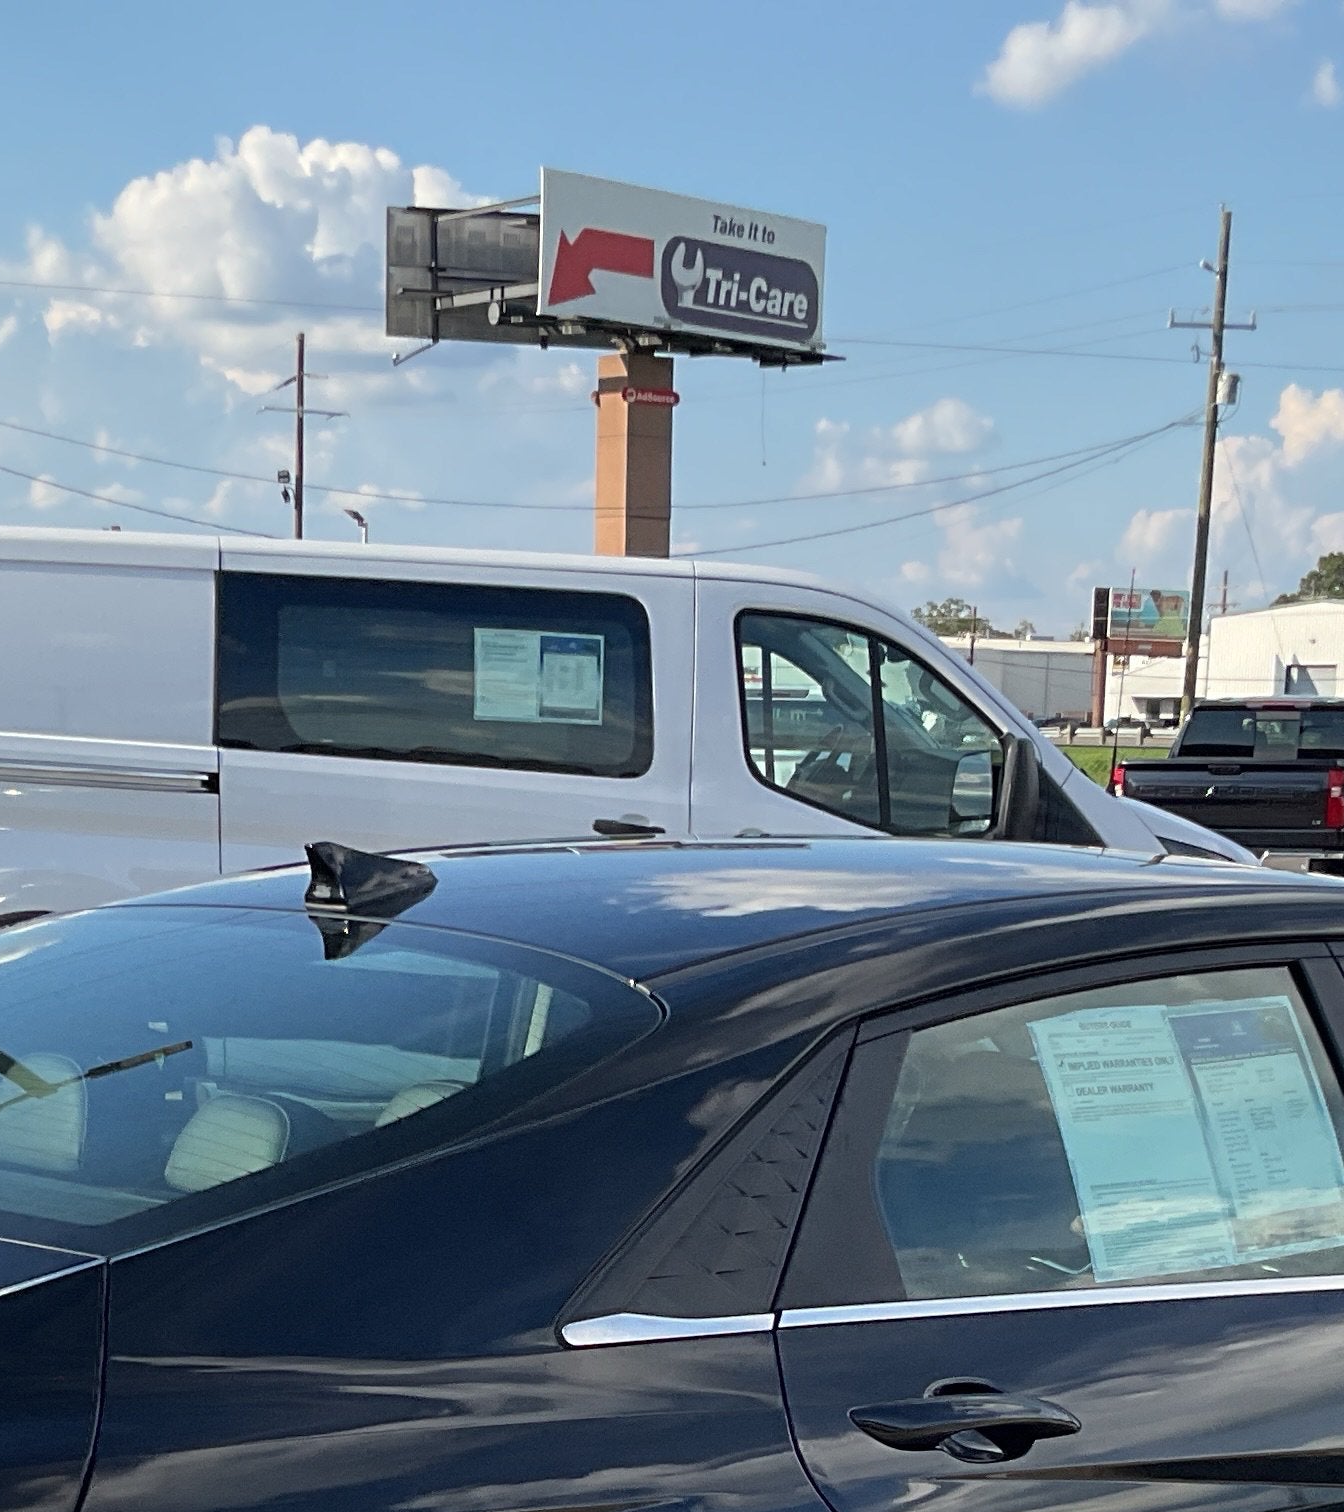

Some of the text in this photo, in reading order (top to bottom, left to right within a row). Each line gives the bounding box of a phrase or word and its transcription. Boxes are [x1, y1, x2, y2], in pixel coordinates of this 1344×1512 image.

[713, 215, 745, 239] Take
[762, 224, 776, 244] to
[706, 267, 808, 320] Tri-Care
[1102, 1057, 1154, 1069] WARRANTIES
[1075, 1082, 1154, 1097] DEALER WARRANTY
